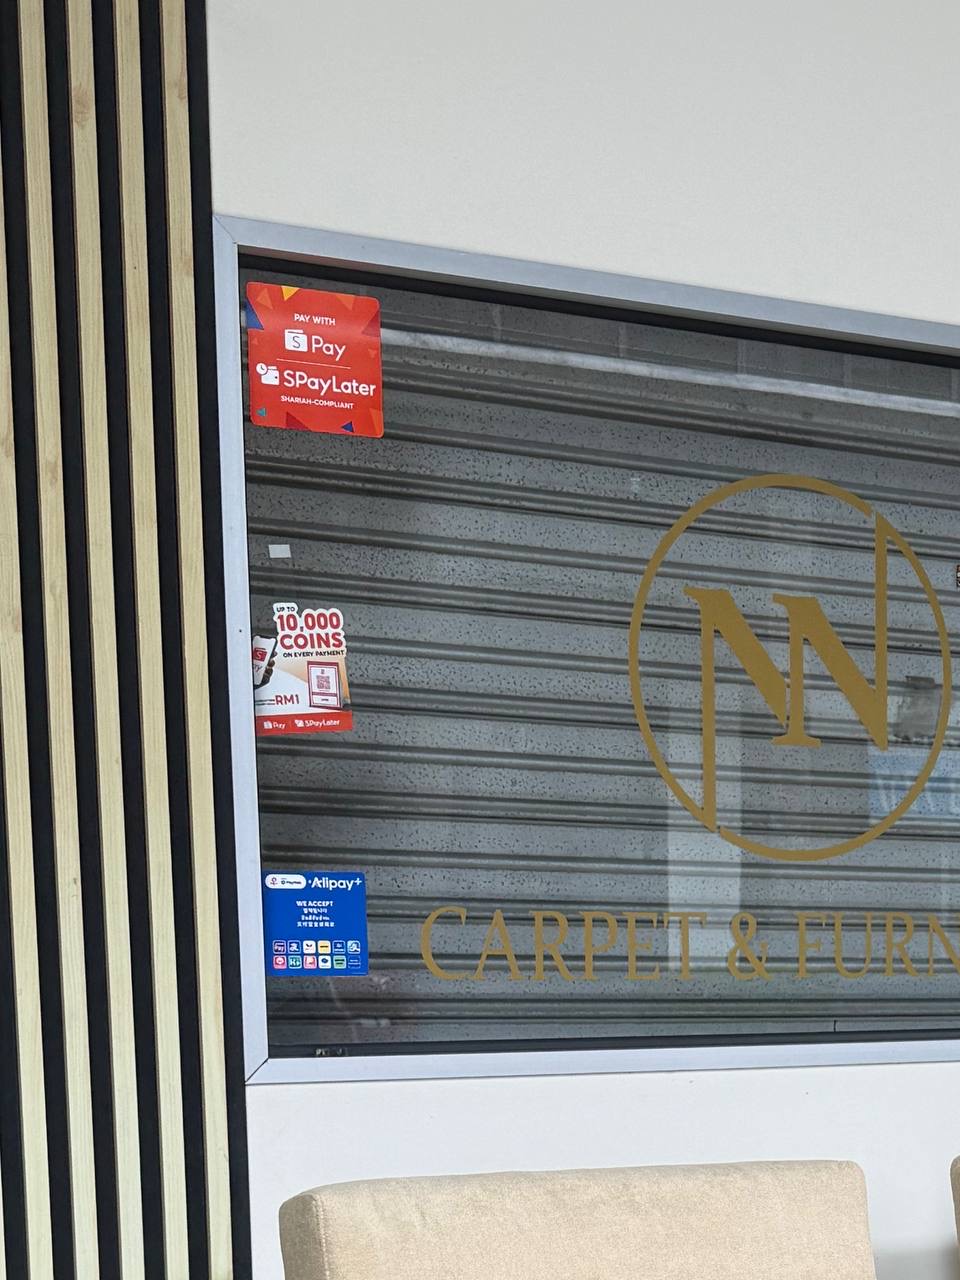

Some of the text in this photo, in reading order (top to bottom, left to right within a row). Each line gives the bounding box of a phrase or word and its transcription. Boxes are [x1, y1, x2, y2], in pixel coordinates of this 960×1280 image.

[294, 313, 336, 326] PAY WITH
[311, 335, 346, 362] Pay
[283, 369, 377, 397] SPayLater
[280, 395, 355, 410] SHARIAH-COMPLIANT
[279, 632, 344, 650] COINS
[315, 649, 345, 657] PAYMENT
[274, 694, 300, 705] RM1
[420, 906, 707, 982] CARPET
[727, 912, 772, 982] &
